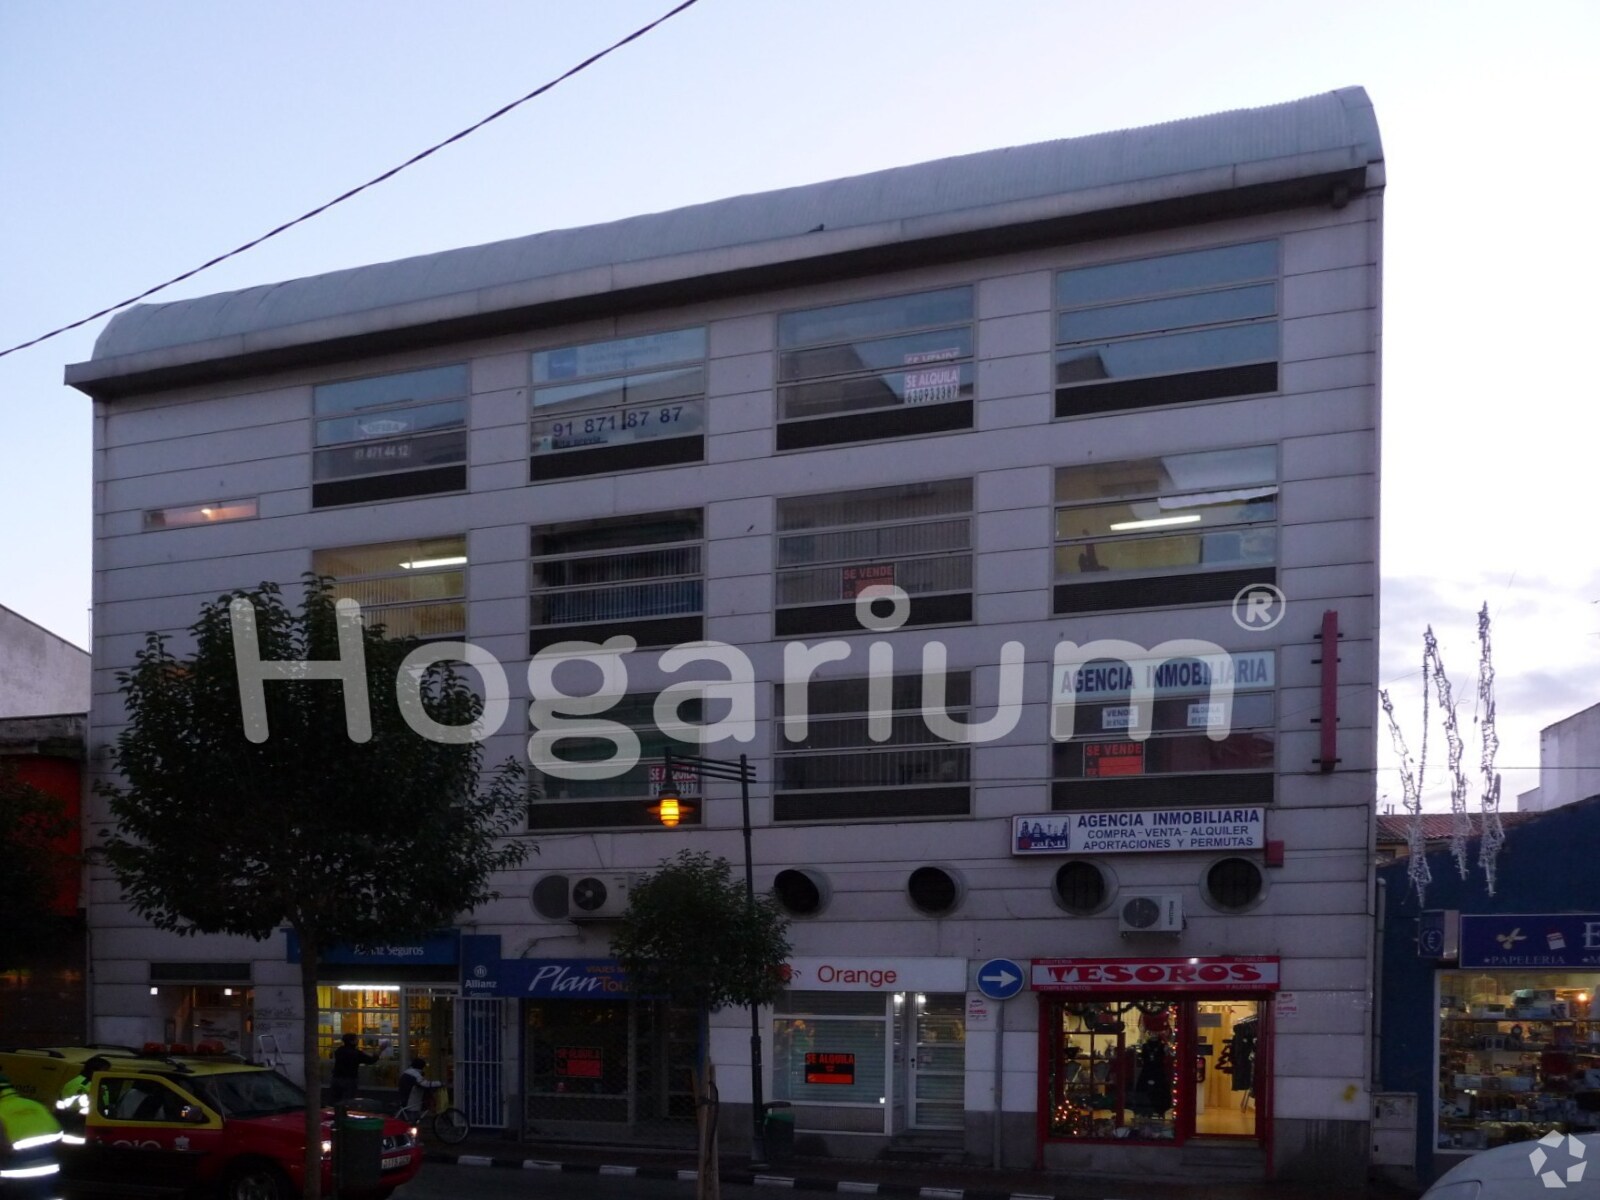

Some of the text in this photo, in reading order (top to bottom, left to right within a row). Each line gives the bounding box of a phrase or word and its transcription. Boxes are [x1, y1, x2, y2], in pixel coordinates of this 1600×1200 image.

[906, 368, 957, 388] SE ALQUILA
[552, 406, 683, 438] 91 871 87 87
[843, 564, 894, 580] SE VENDE
[1060, 657, 1269, 694] AGENCIA INMOBILIARIA
[1086, 742, 1142, 756] SE VENDE
[650, 766, 698, 782] SE AQUILA
[1077, 810, 1260, 828] AGENCIA INMOBILIARIA
[1082, 836, 1254, 851] APORTACIONES Y PERMUTAS
[386, 944, 424, 958] Seguros
[1490, 955, 1567, 965] PAPELERIA
[528, 965, 602, 992] Plan
[817, 965, 897, 988] Orange
[1047, 964, 1262, 983] TESOROS
[464, 979, 498, 989] Allianz
[806, 1053, 854, 1065] SE ALQUILA
